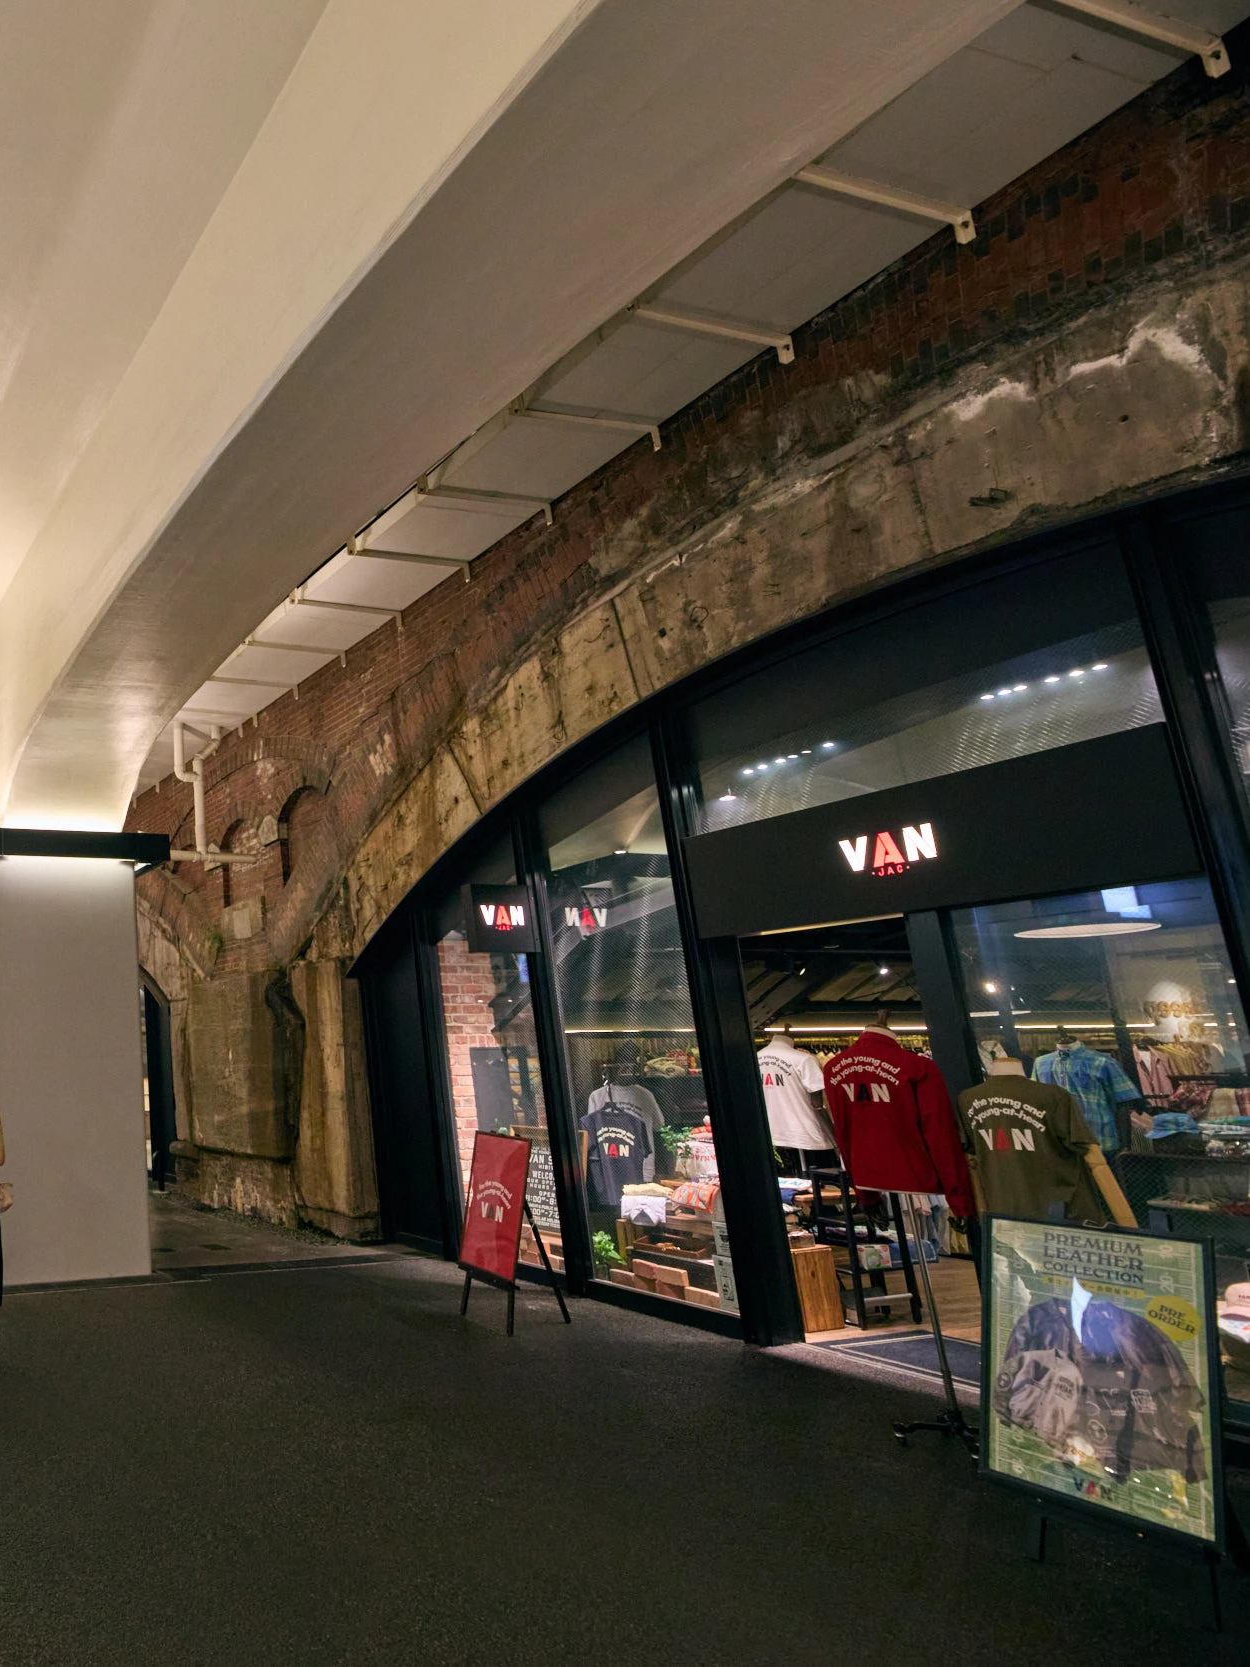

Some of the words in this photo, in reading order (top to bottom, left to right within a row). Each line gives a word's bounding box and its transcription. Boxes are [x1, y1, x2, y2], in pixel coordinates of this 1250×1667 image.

[838, 822, 938, 872] VAN
[480, 904, 525, 926] VAN
[840, 1056, 853, 1067] the
[853, 1056, 881, 1067] young
[880, 1061, 901, 1075] and
[830, 1075, 842, 1086] the
[841, 1083, 891, 1103] VAN
[972, 1098, 988, 1109] the
[987, 1097, 1022, 1109] young
[1022, 1103, 1047, 1119] and
[602, 1142, 630, 1158] VAN
[978, 1127, 1036, 1152] VAN
[532, 1170, 554, 1180] WELCO
[541, 1179, 556, 1187] OPE
[539, 1190, 555, 1198] OPEN
[673, 1185, 709, 1210] 1975
[481, 1200, 504, 1223] VAN
[1043, 1231, 1144, 1257] PREMIUM
[1043, 1245, 1144, 1272] LEATHER
[1042, 1260, 1144, 1285] COLLECTION
[1147, 1309, 1197, 1335] ORDER
[1072, 1475, 1113, 1500] VAN
